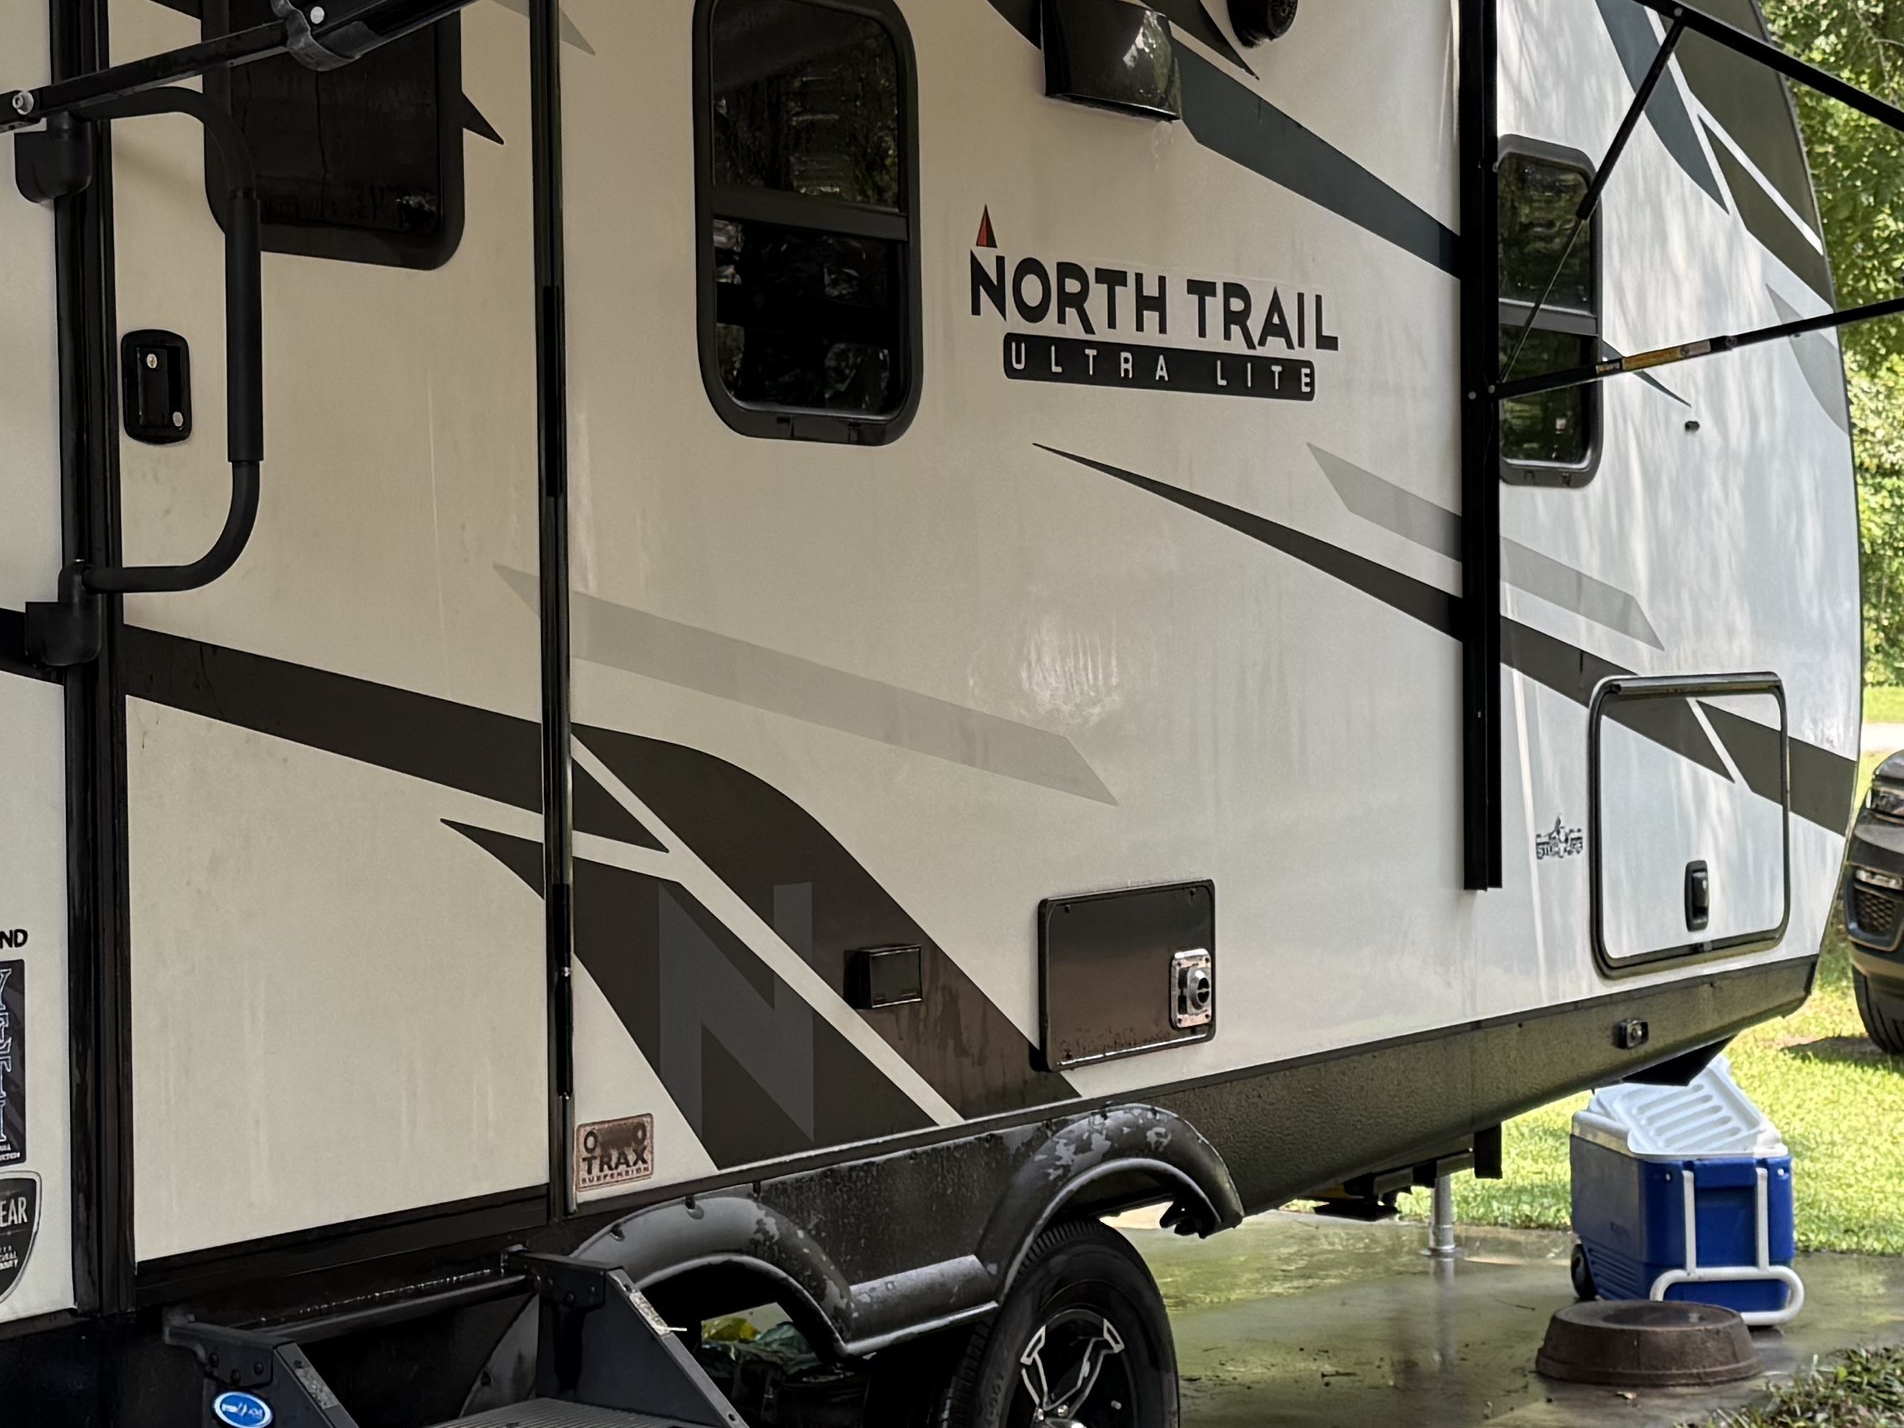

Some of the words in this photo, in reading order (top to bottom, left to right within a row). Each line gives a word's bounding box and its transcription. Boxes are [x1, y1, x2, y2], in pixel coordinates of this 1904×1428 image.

[970, 249, 1167, 335] NORTH
[1187, 278, 1339, 352] TRAIL
[1011, 341, 1169, 381] ULTRA
[1216, 359, 1311, 393] LITE
[582, 1145, 648, 1175] TRAX
